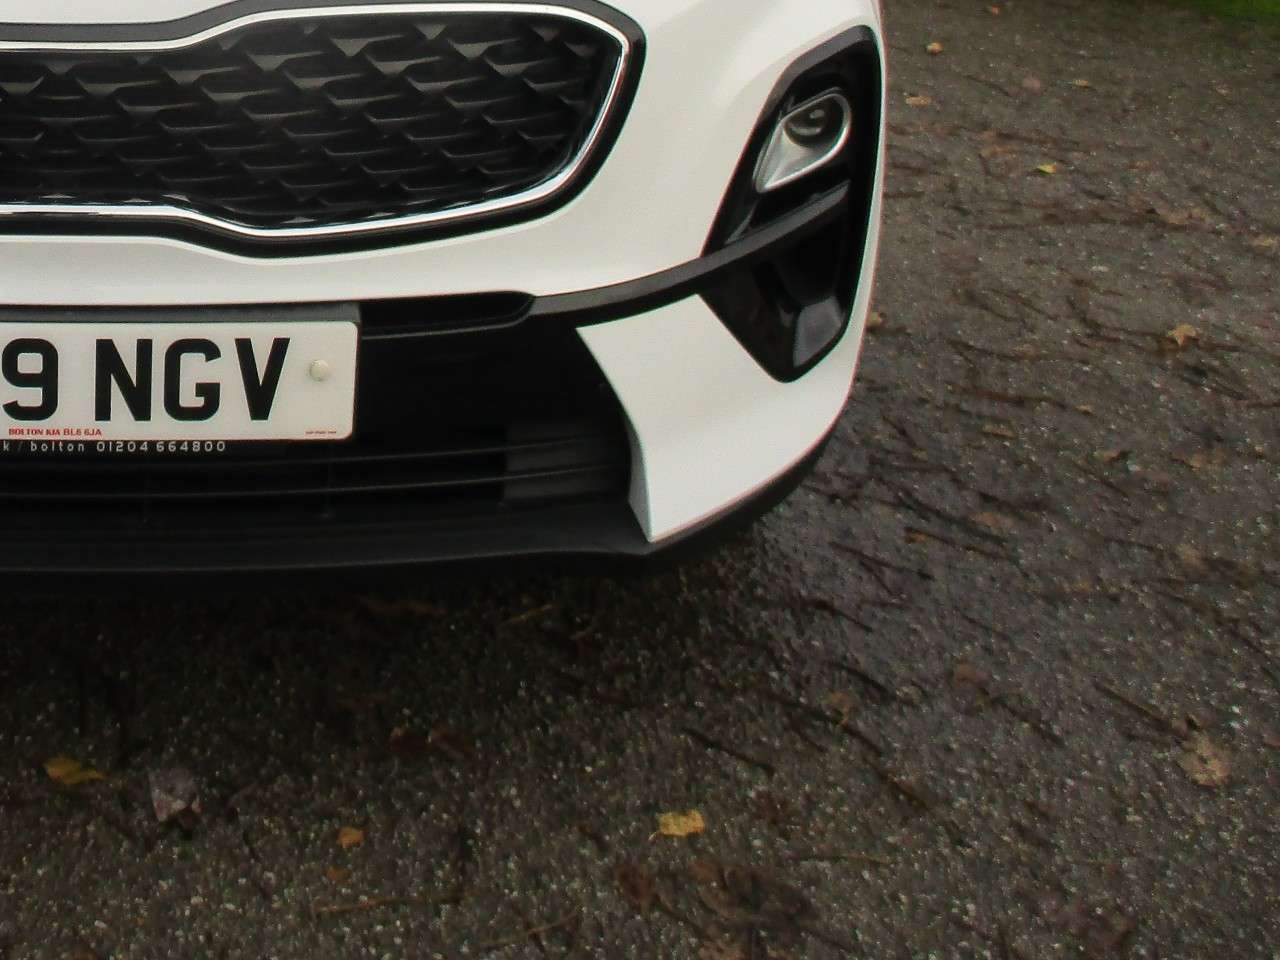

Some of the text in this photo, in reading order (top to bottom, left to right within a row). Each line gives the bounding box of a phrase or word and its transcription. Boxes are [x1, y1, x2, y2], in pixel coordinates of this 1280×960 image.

[93, 337, 290, 422] NGV
[8, 428, 44, 437] BOLTON
[30, 441, 85, 452] bolton
[96, 441, 148, 453] 01204
[156, 441, 226, 453] 664800
